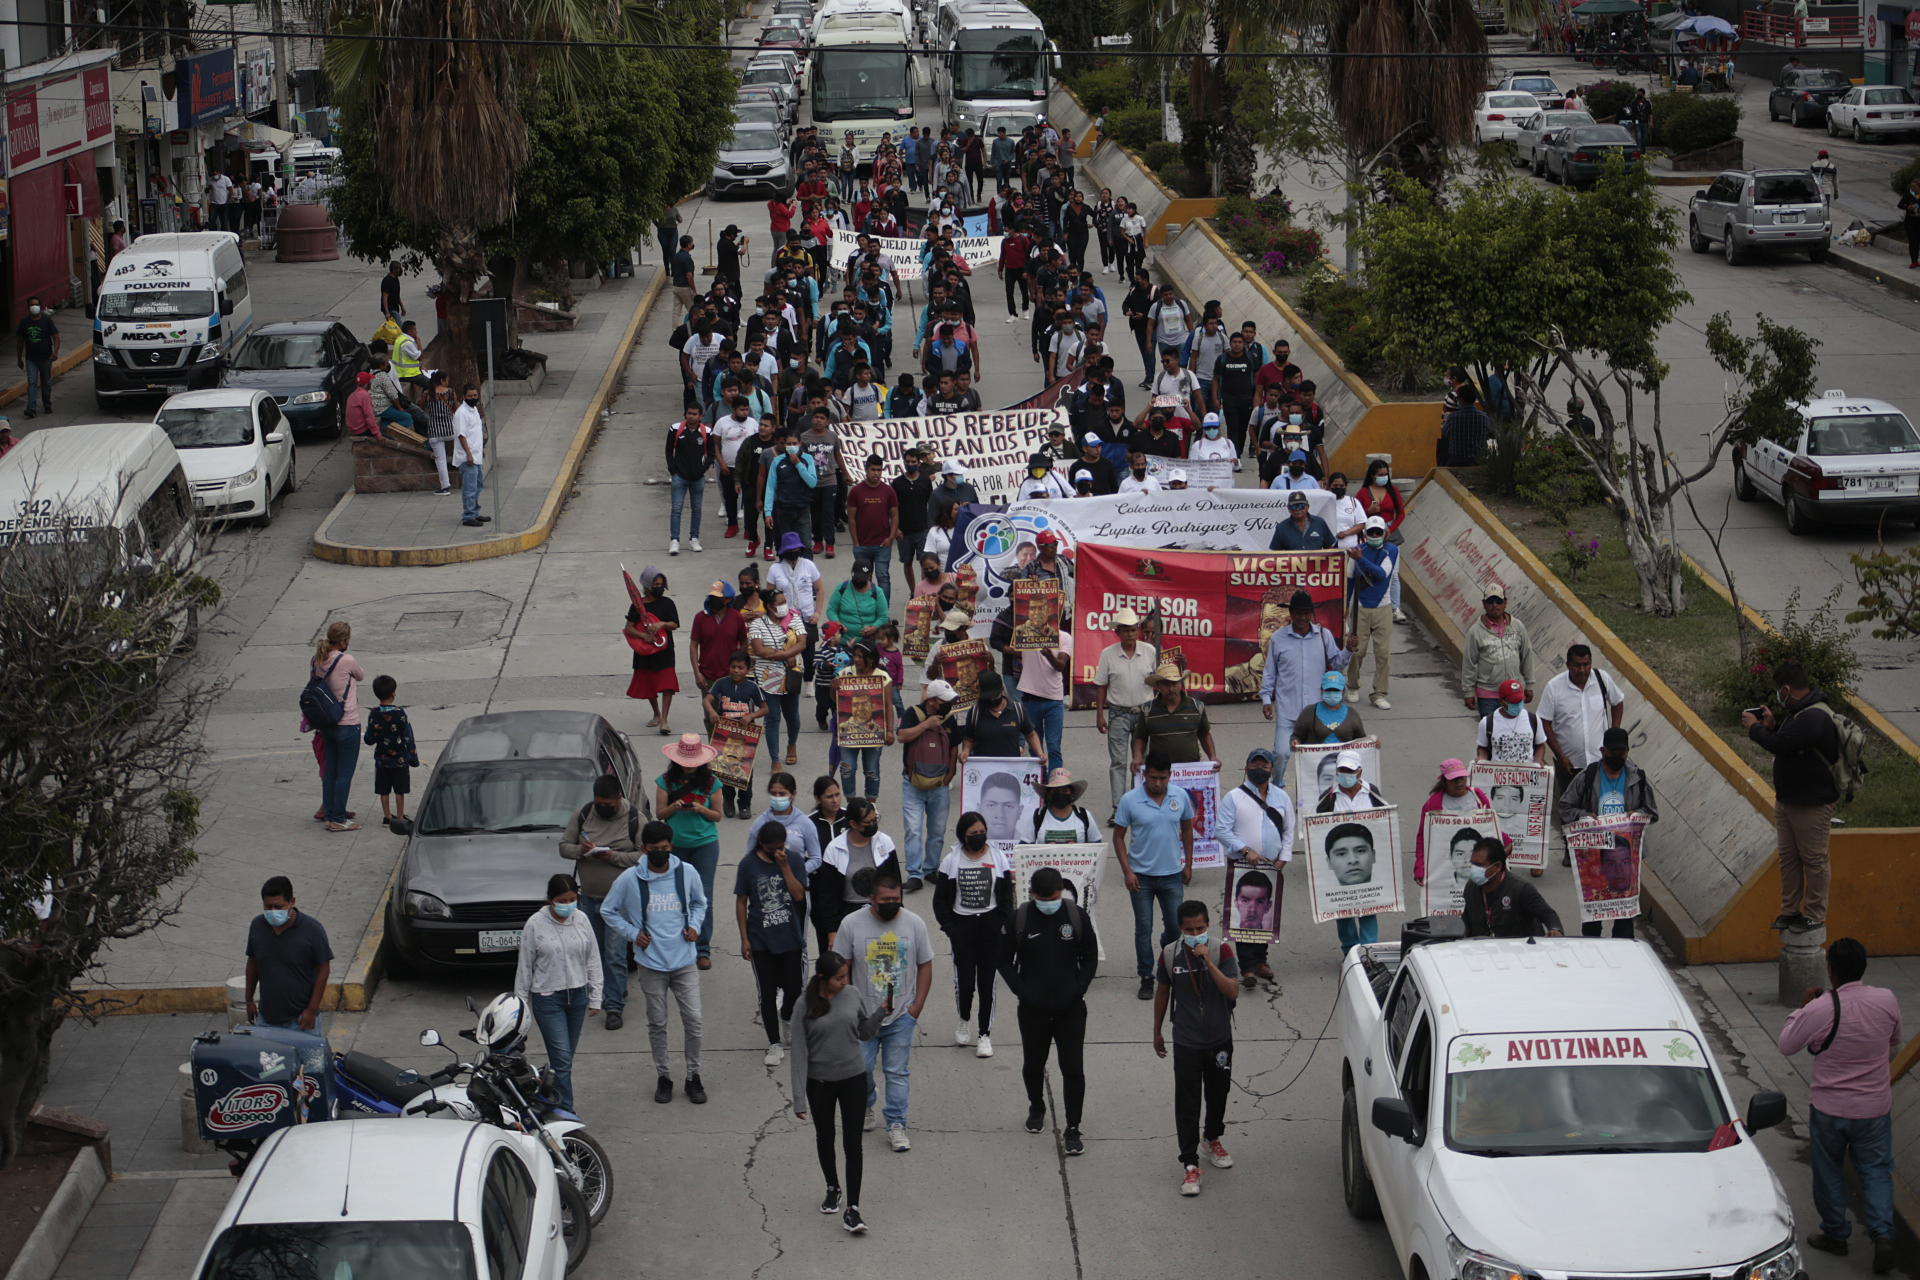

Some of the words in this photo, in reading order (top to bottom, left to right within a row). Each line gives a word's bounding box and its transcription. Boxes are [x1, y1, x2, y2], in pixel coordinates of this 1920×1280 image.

[86, 101, 111, 131] GIOVANNA
[818, 128, 833, 136] 2520
[9, 123, 40, 157] GIOVANNA
[980, 250, 992, 258] LA
[114, 264, 136, 277] 483
[124, 281, 191, 291] POLVORIN
[157, 305, 179, 313] GENERAL
[104, 323, 118, 338] 483
[122, 332, 168, 341] MEGA
[1832, 406, 1873, 414] 781
[831, 422, 867, 438] NO
[873, 420, 920, 440] SON
[925, 415, 958, 438] LOS
[963, 408, 1061, 436] REBELDES
[839, 439, 868, 457] LOS
[872, 440, 908, 462] QUE
[988, 432, 1018, 453] LOS
[983, 474, 1003, 491] POR
[1008, 470, 1028, 489] ACC
[1844, 478, 1862, 487] 781
[18, 499, 51, 518] 342
[1010, 505, 1048, 515] COLECTIVO
[1048, 513, 1058, 521] DE
[1115, 502, 1174, 515] Colectivo
[1176, 501, 1193, 512] de
[1152, 520, 1240, 537] Rodríguez
[1243, 517, 1279, 532] Nar
[1232, 556, 1341, 573] VICENTE
[1017, 580, 1057, 588] VICENTE
[1230, 572, 1340, 587] SUASTEGUI
[1086, 611, 1213, 637] COTARIO
[942, 641, 983, 653] VICENTE
[947, 647, 984, 657] UASTEGUI
[840, 677, 882, 685] VICENTE
[717, 723, 759, 739] SUASTEGUI
[720, 718, 761, 732] VICTE
[1473, 766, 1494, 774] ¡Vivo
[1023, 773, 1039, 786] 43
[1494, 772, 1507, 785] NOS
[1508, 771, 1530, 785] FALTAN
[1308, 817, 1330, 827] ¡Vivo
[1352, 809, 1388, 821] llevaron!
[1431, 816, 1451, 825] ¡Vivo
[1452, 817, 1462, 825] se
[1463, 816, 1471, 825] lo
[1472, 815, 1494, 824] llevaron!
[1529, 803, 1544, 824] FALTAN
[1528, 823, 1542, 836] NOS
[1568, 822, 1590, 832] ¡Vivo
[1592, 819, 1602, 827] se
[1568, 833, 1580, 846] NOS
[1581, 832, 1604, 847] FALTAN
[998, 842, 1014, 851] TIZAPA
[1026, 859, 1043, 868] ¡Vivo
[1053, 859, 1060, 867] lo
[1060, 858, 1092, 867] llevaron!
[1507, 852, 1539, 861] queremos!
[1349, 885, 1384, 895] GETSEMANY
[649, 893, 676, 904] TRUE
[1329, 895, 1359, 903] SÁNCHEZ
[1359, 891, 1381, 900] GARCÍA
[646, 901, 682, 912] TTITUD
[1320, 911, 1335, 921] ¡Con
[1336, 908, 1353, 918] VIDA
[1354, 908, 1360, 916] lo
[1361, 903, 1394, 915] queremos!
[1592, 912, 1605, 921] ¡Con
[1607, 910, 1620, 918] VIDA
[1621, 909, 1627, 917] lo
[1507, 1037, 1648, 1062] AYOTZINAPA
[203, 1071, 216, 1083] 01
[217, 1093, 277, 1113] VITOR'S
[223, 1113, 275, 1123] pizzas
